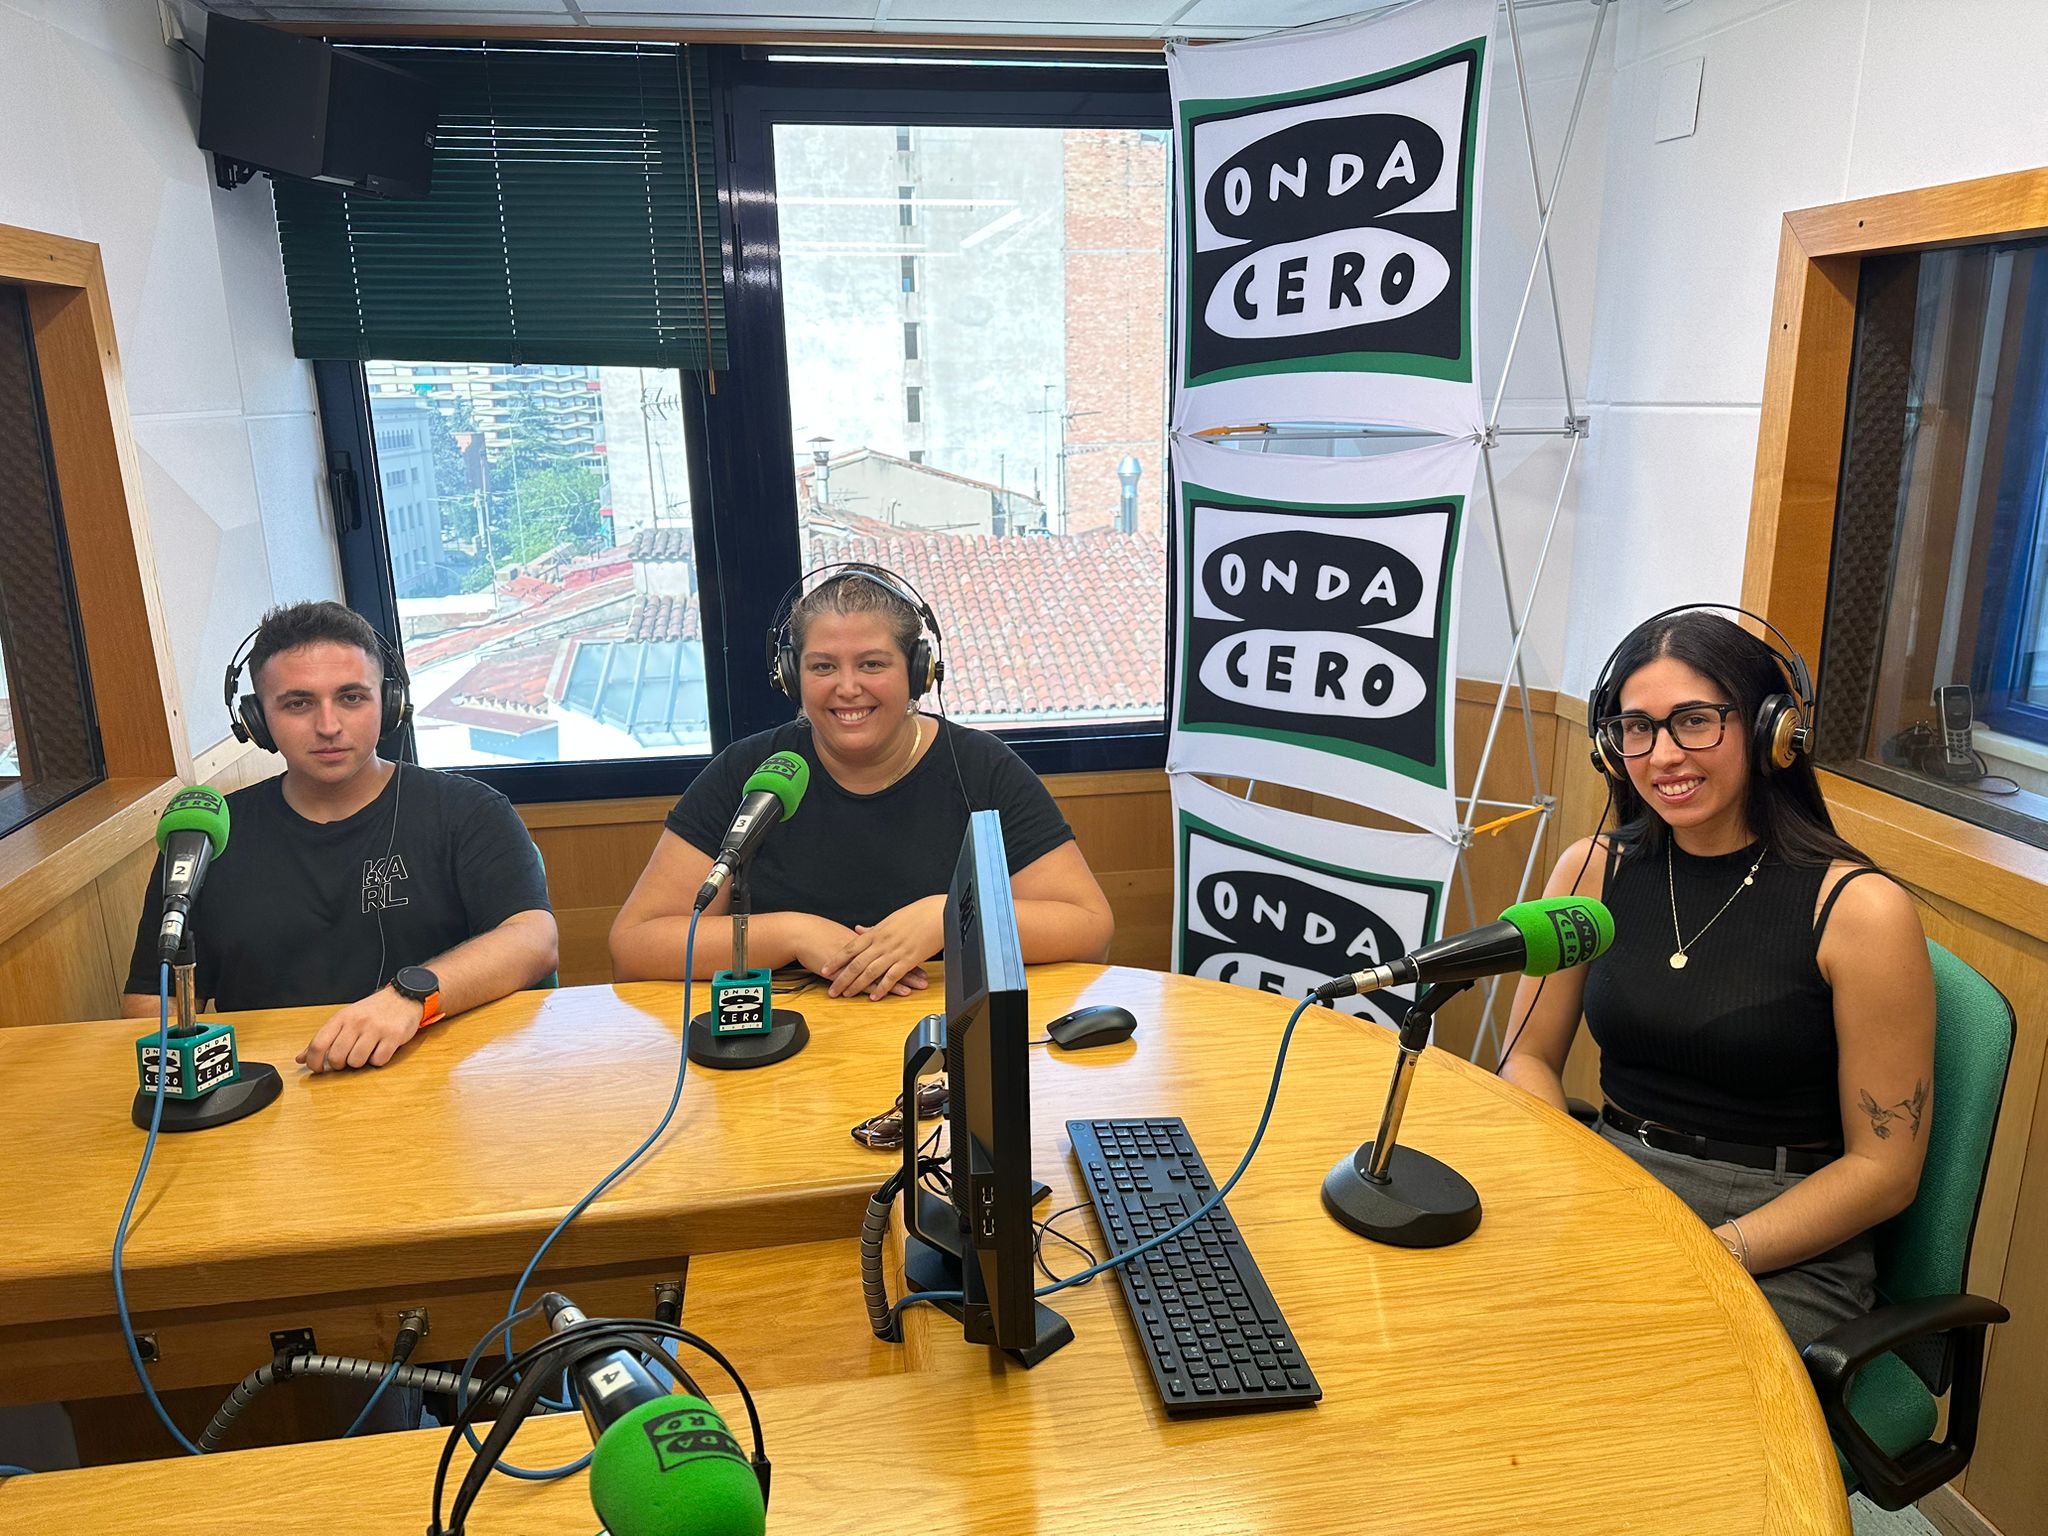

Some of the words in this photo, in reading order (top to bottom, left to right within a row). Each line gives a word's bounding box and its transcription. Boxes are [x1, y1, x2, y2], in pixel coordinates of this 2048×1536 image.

[1223, 139, 1416, 216] ONDA
[1233, 251, 1415, 320] CERO
[1220, 553, 1397, 607] ONDA
[1226, 640, 1394, 707] CERO
[736, 819, 746, 828] 3
[174, 865, 186, 875] 2
[1213, 881, 1382, 966] ONDA
[1560, 918, 1578, 963] CERO
[1576, 914, 1593, 959] ONDA
[723, 988, 760, 997] ONDA
[720, 1012, 759, 1023] CERO
[145, 1048, 177, 1057] ONA
[197, 1035, 228, 1054] ONDA
[197, 1062, 230, 1083] CERO
[600, 1369, 621, 1386] 4
